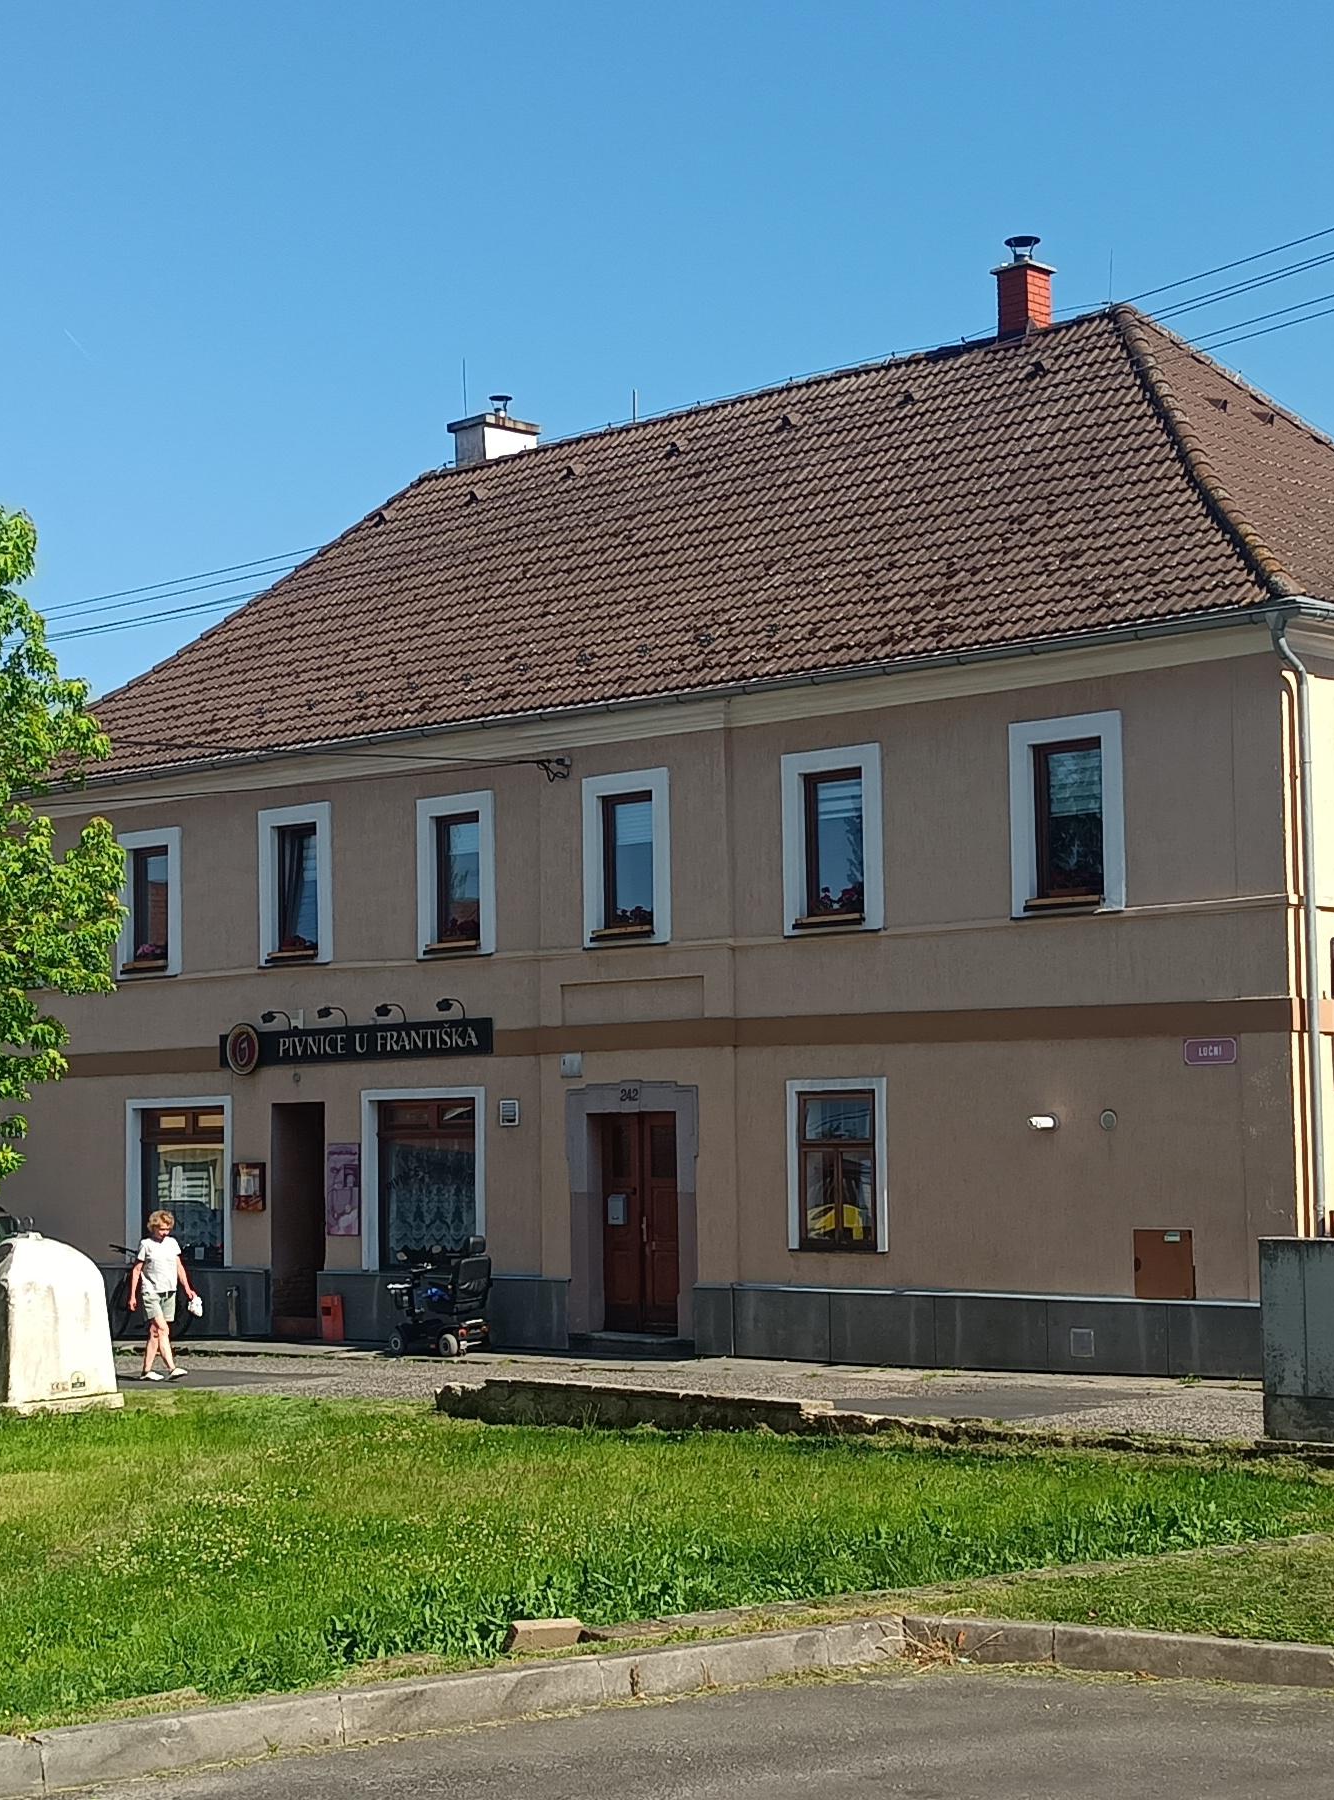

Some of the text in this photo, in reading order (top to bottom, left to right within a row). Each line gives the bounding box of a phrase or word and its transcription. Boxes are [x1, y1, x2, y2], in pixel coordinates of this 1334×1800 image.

[278, 1023, 479, 1057] PIVNICE U FRANTIŠKA
[619, 1088, 639, 1102] 242
